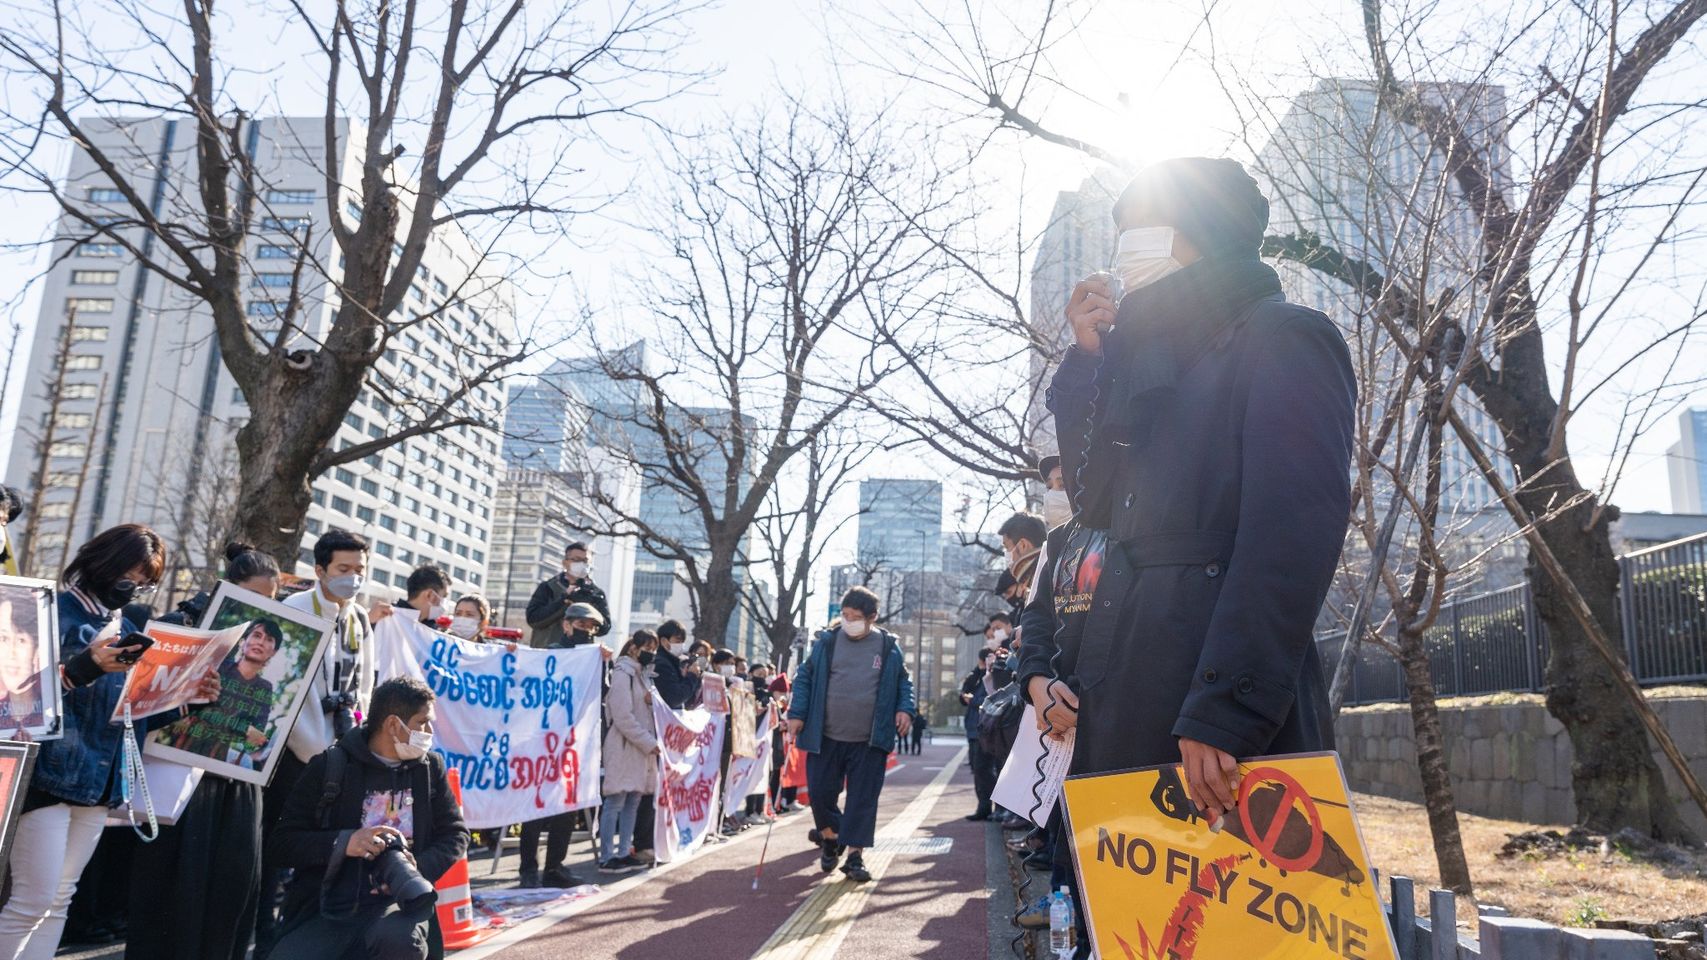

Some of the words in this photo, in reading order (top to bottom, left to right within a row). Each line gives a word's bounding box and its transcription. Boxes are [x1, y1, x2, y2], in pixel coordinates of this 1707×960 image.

[1096, 827, 1157, 876] NO
[1165, 847, 1239, 905] FLY
[1246, 877, 1368, 960] ZONE
